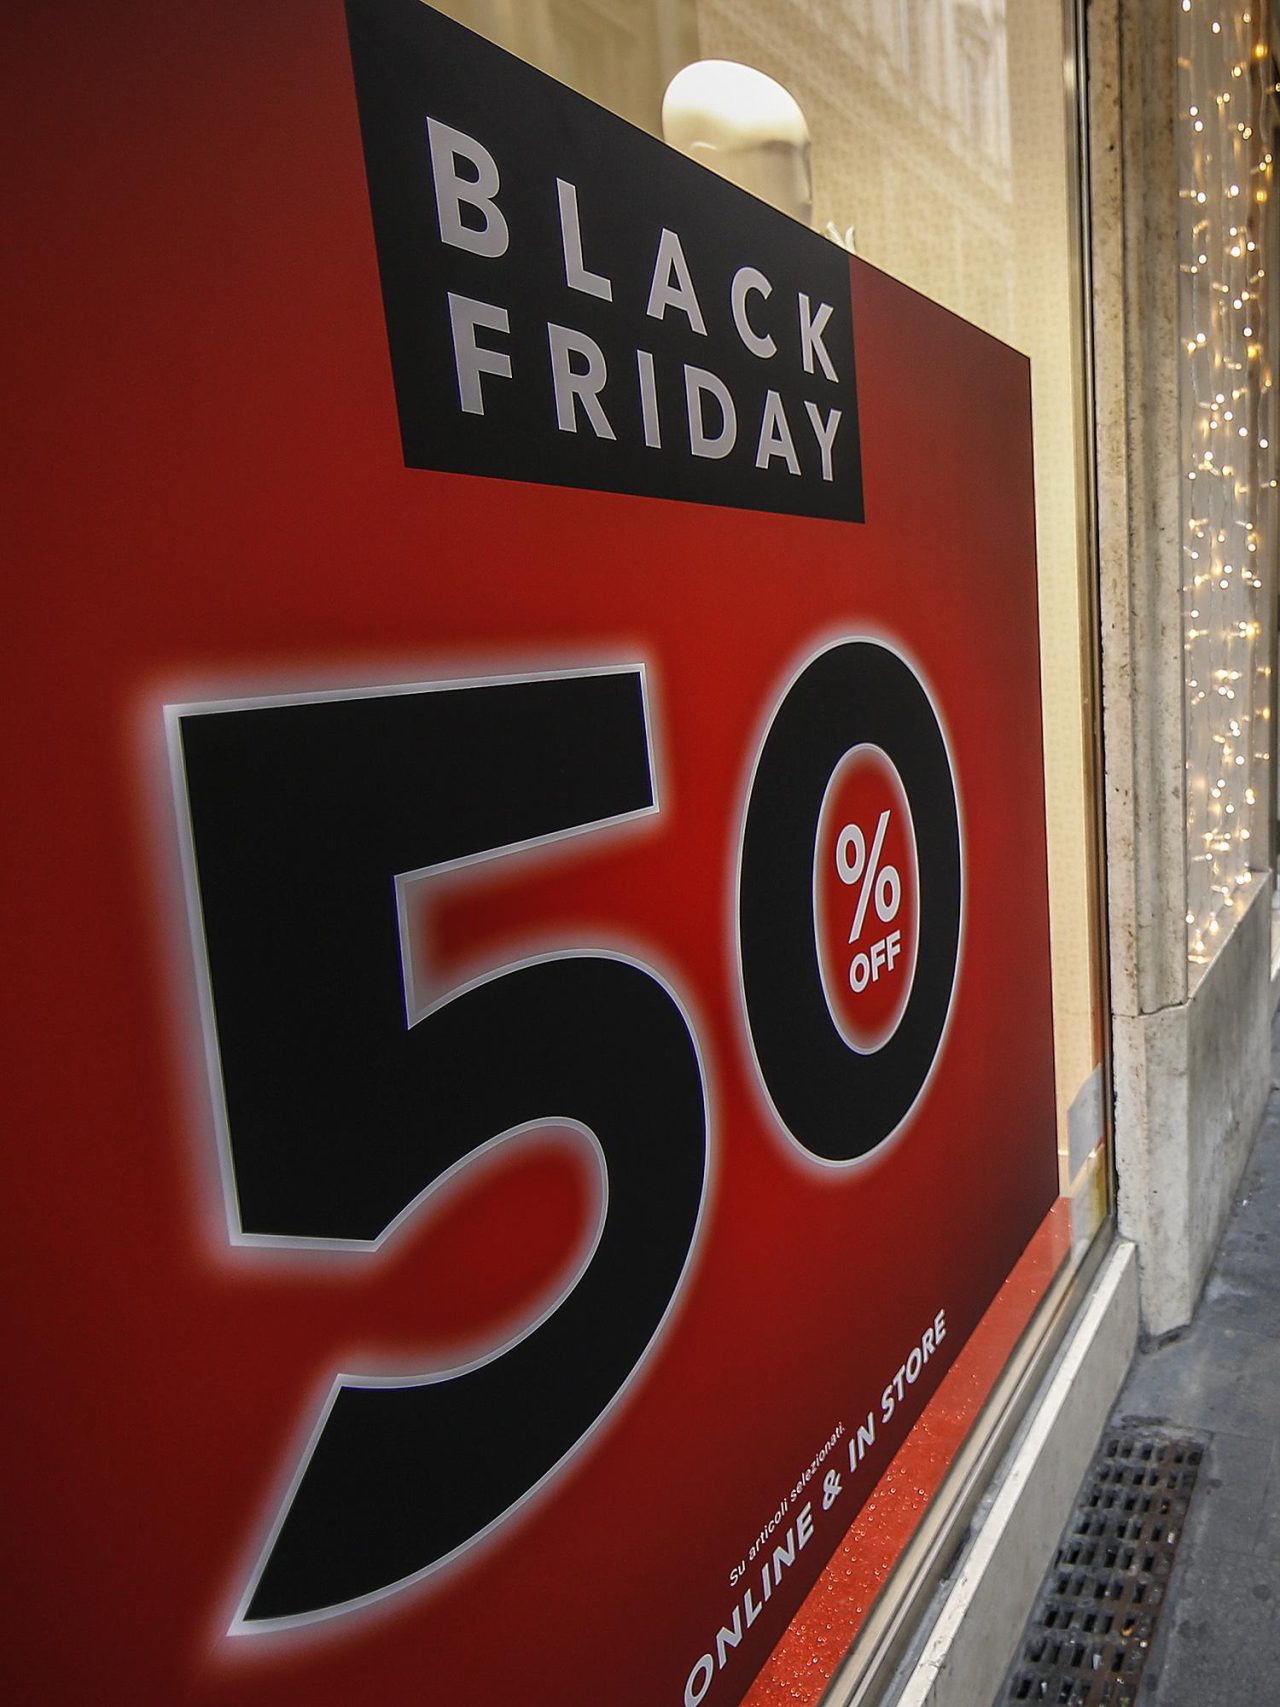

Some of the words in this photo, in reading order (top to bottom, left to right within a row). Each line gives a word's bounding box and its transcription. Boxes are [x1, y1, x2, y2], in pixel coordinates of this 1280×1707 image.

[425, 115, 840, 384] BLACK
[446, 291, 842, 482] FRIDAY
[849, 929, 901, 993] OFF
[683, 1501, 815, 1707] ONLINE
[822, 1468, 843, 1511] &
[849, 1411, 876, 1473] IN
[881, 1308, 947, 1425] STORE
[728, 1562, 746, 1587] Su
[748, 1498, 788, 1562] articoli
[790, 1421, 846, 1503] selezionati.
